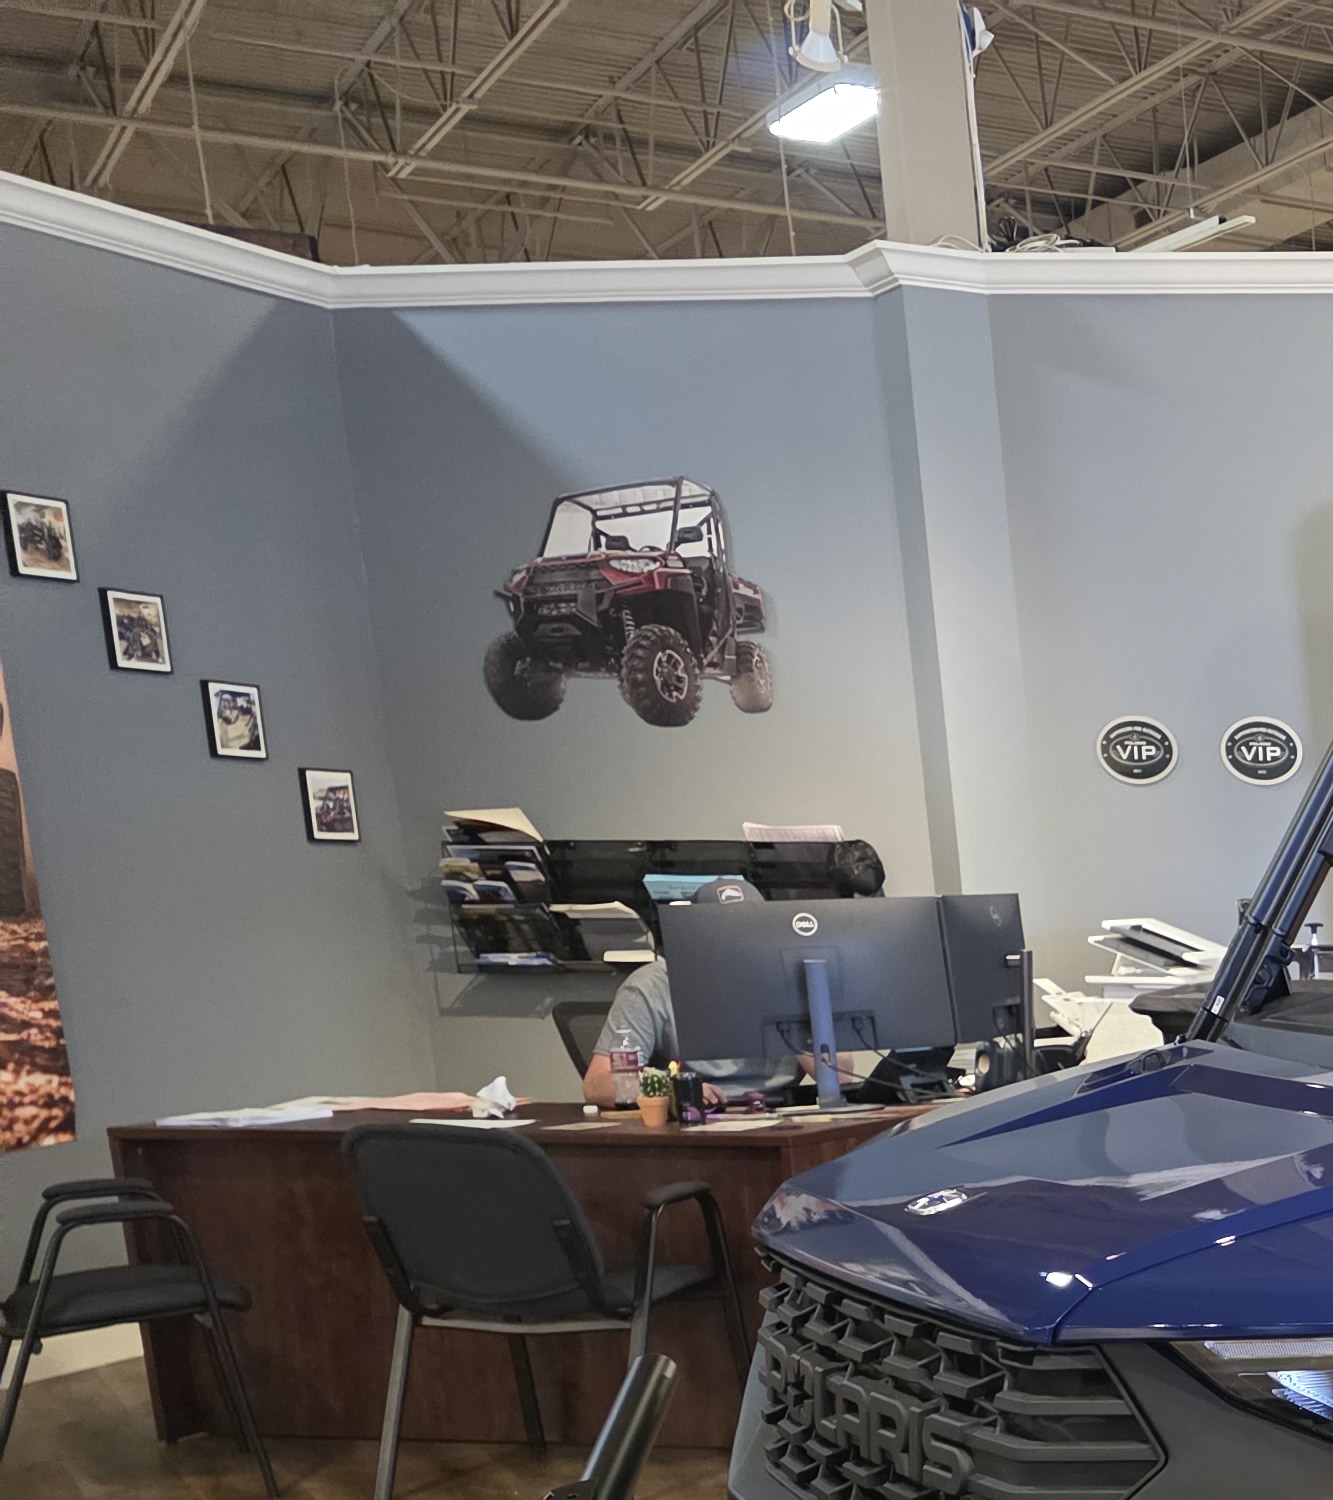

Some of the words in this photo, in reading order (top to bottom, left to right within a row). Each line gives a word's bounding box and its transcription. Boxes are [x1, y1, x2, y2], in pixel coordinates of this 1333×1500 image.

[1116, 745, 1156, 760] VIP
[1241, 746, 1281, 761] VIP
[765, 1335, 974, 1495] POLARIS
